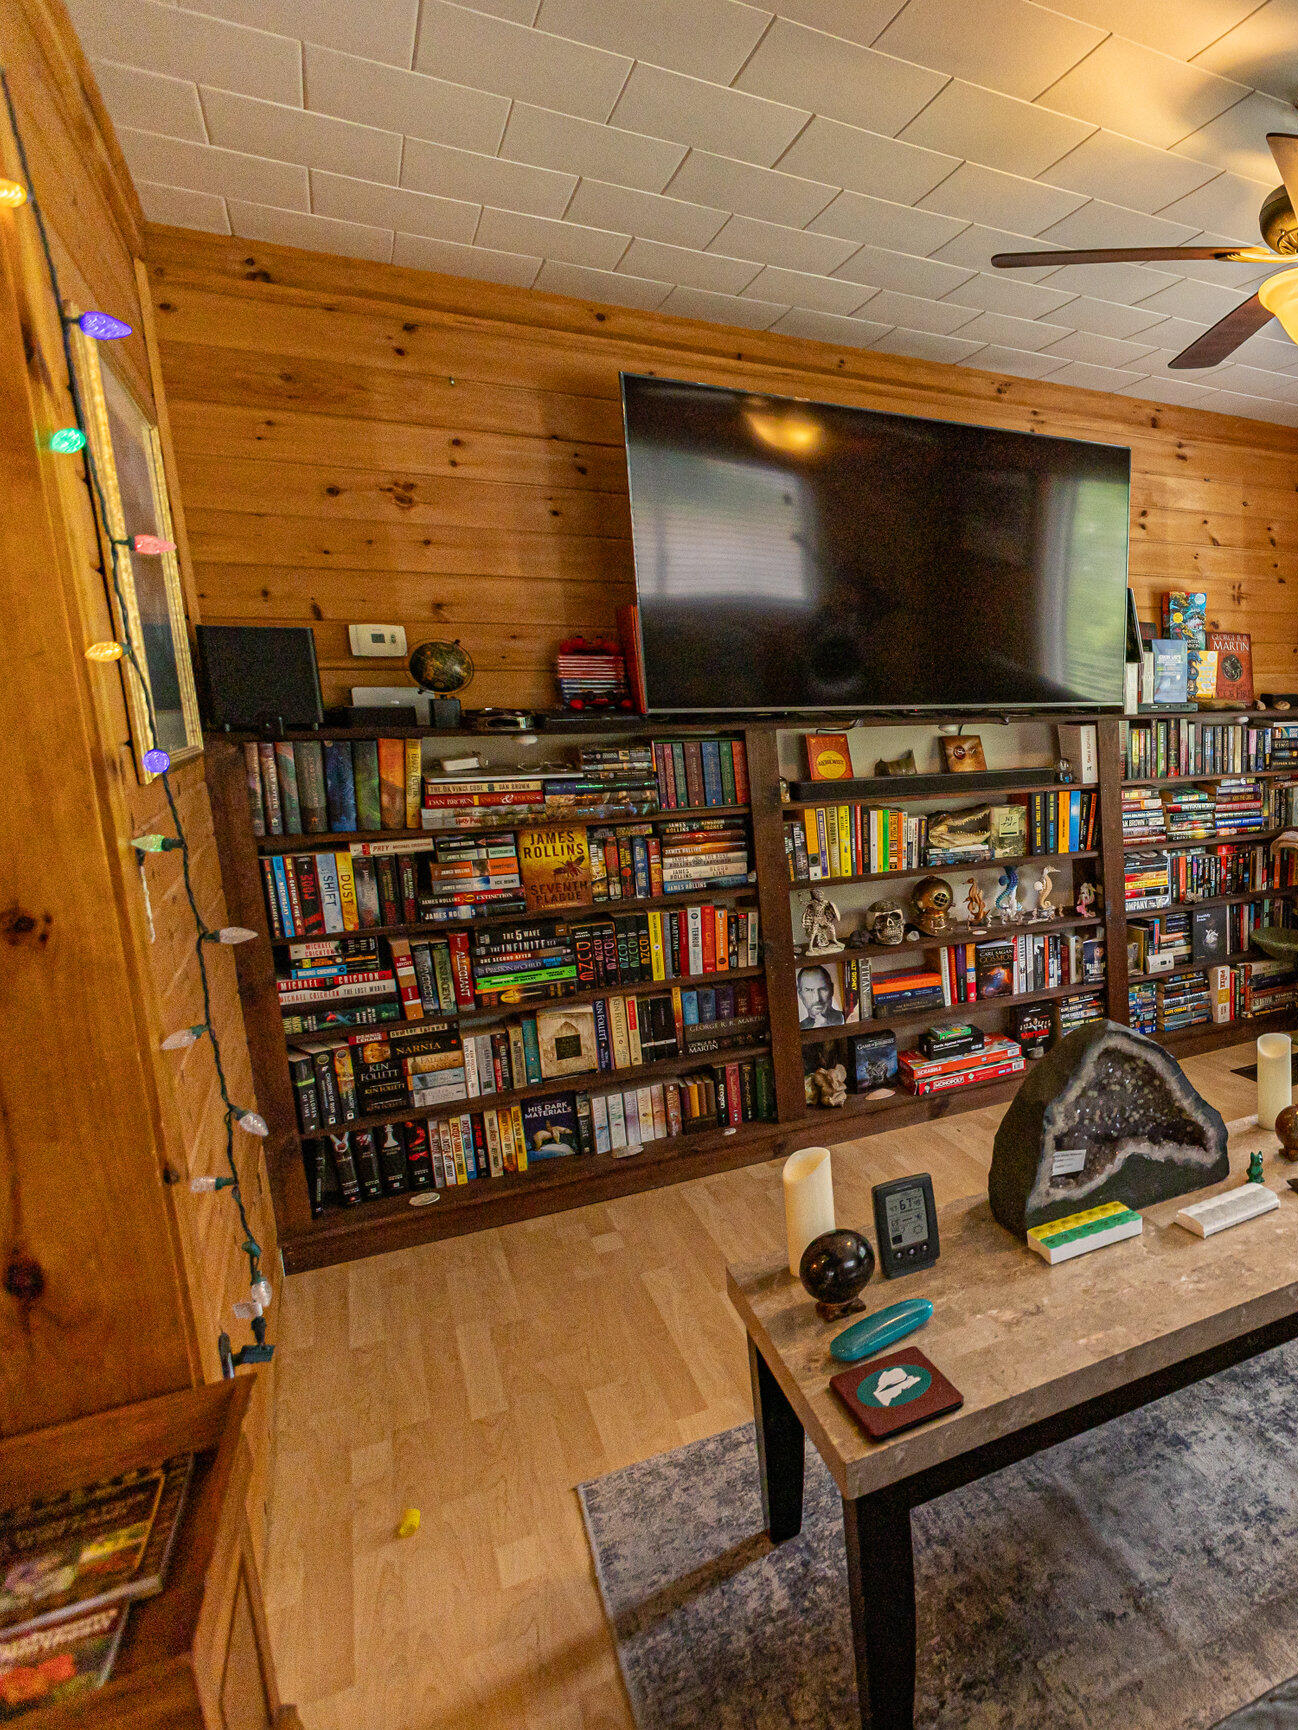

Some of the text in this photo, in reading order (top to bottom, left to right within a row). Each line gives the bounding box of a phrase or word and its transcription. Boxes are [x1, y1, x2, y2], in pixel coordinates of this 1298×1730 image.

[1211, 633, 1234, 641] GEORGE
[1213, 641, 1249, 652] MARTIN
[410, 775, 421, 799] POTTER
[428, 794, 513, 806] DAN BROWN &
[829, 822, 837, 845] ROBBINS
[373, 844, 390, 853] PREY
[590, 844, 600, 866] ROLLINS
[619, 848, 627, 868] ROLLINS
[523, 830, 588, 904] JAMES ROLLINS SEVENTH PLAGUE
[323, 875, 339, 907] SHIFT
[340, 874, 355, 906] DUST
[667, 882, 707, 892] JAMES ROLLINS
[438, 896, 462, 904] ROLLINS
[476, 892, 513, 901] EXTINCTION
[425, 908, 476, 920] JAMES ROLS
[1125, 901, 1148, 912] OMPANY
[502, 932, 514, 940] THE
[523, 929, 541, 938] WAVE
[672, 919, 680, 950] MARTIAN
[304, 941, 336, 958] MICHAEL CRICHTON
[501, 939, 546, 952] INFINITE
[492, 955, 513, 963] SECOND
[979, 948, 1014, 962] CARL SAGAN COSMOS
[280, 972, 380, 991] MICHAEL CRICHTON
[456, 951, 471, 997] ALLEGIANT
[860, 959, 872, 994] TITAN
[420, 963, 434, 1006] DIVERGENT
[438, 961, 451, 1005] INSURGENT
[279, 993, 306, 1003] MICHAEL
[309, 990, 340, 1000] CRICHTON
[595, 1000, 607, 1042] KEN FOLLETT
[612, 999, 624, 1038] KEN FOLLETT
[689, 1022, 719, 1032] GEORGE
[737, 1015, 767, 1024] MARTIN
[356, 1036, 383, 1044] LEHANE
[390, 1028, 417, 1038] Shutter
[857, 1037, 895, 1051] GAME THRONES
[395, 1042, 442, 1055] NARNIA
[689, 1043, 719, 1053] MARTIN
[420, 1056, 437, 1064] FALL
[501, 1056, 509, 1078] FOLLETT
[360, 1062, 398, 1082] KEN FOLLETT
[485, 1060, 493, 1080] FOLLETT
[917, 1066, 943, 1076] SCRABBLE
[324, 1073, 334, 1095] CHILDREN
[364, 1083, 405, 1095] KEN FOLLETT
[934, 1077, 964, 1089] MONOPOLY
[308, 1089, 317, 1118] CHILDREN
[527, 1101, 568, 1114] HIS DARK
[524, 1106, 572, 1120] MATERIALS
[451, 1122, 461, 1138] DEXTER
[442, 1138, 452, 1154] DEXTER
